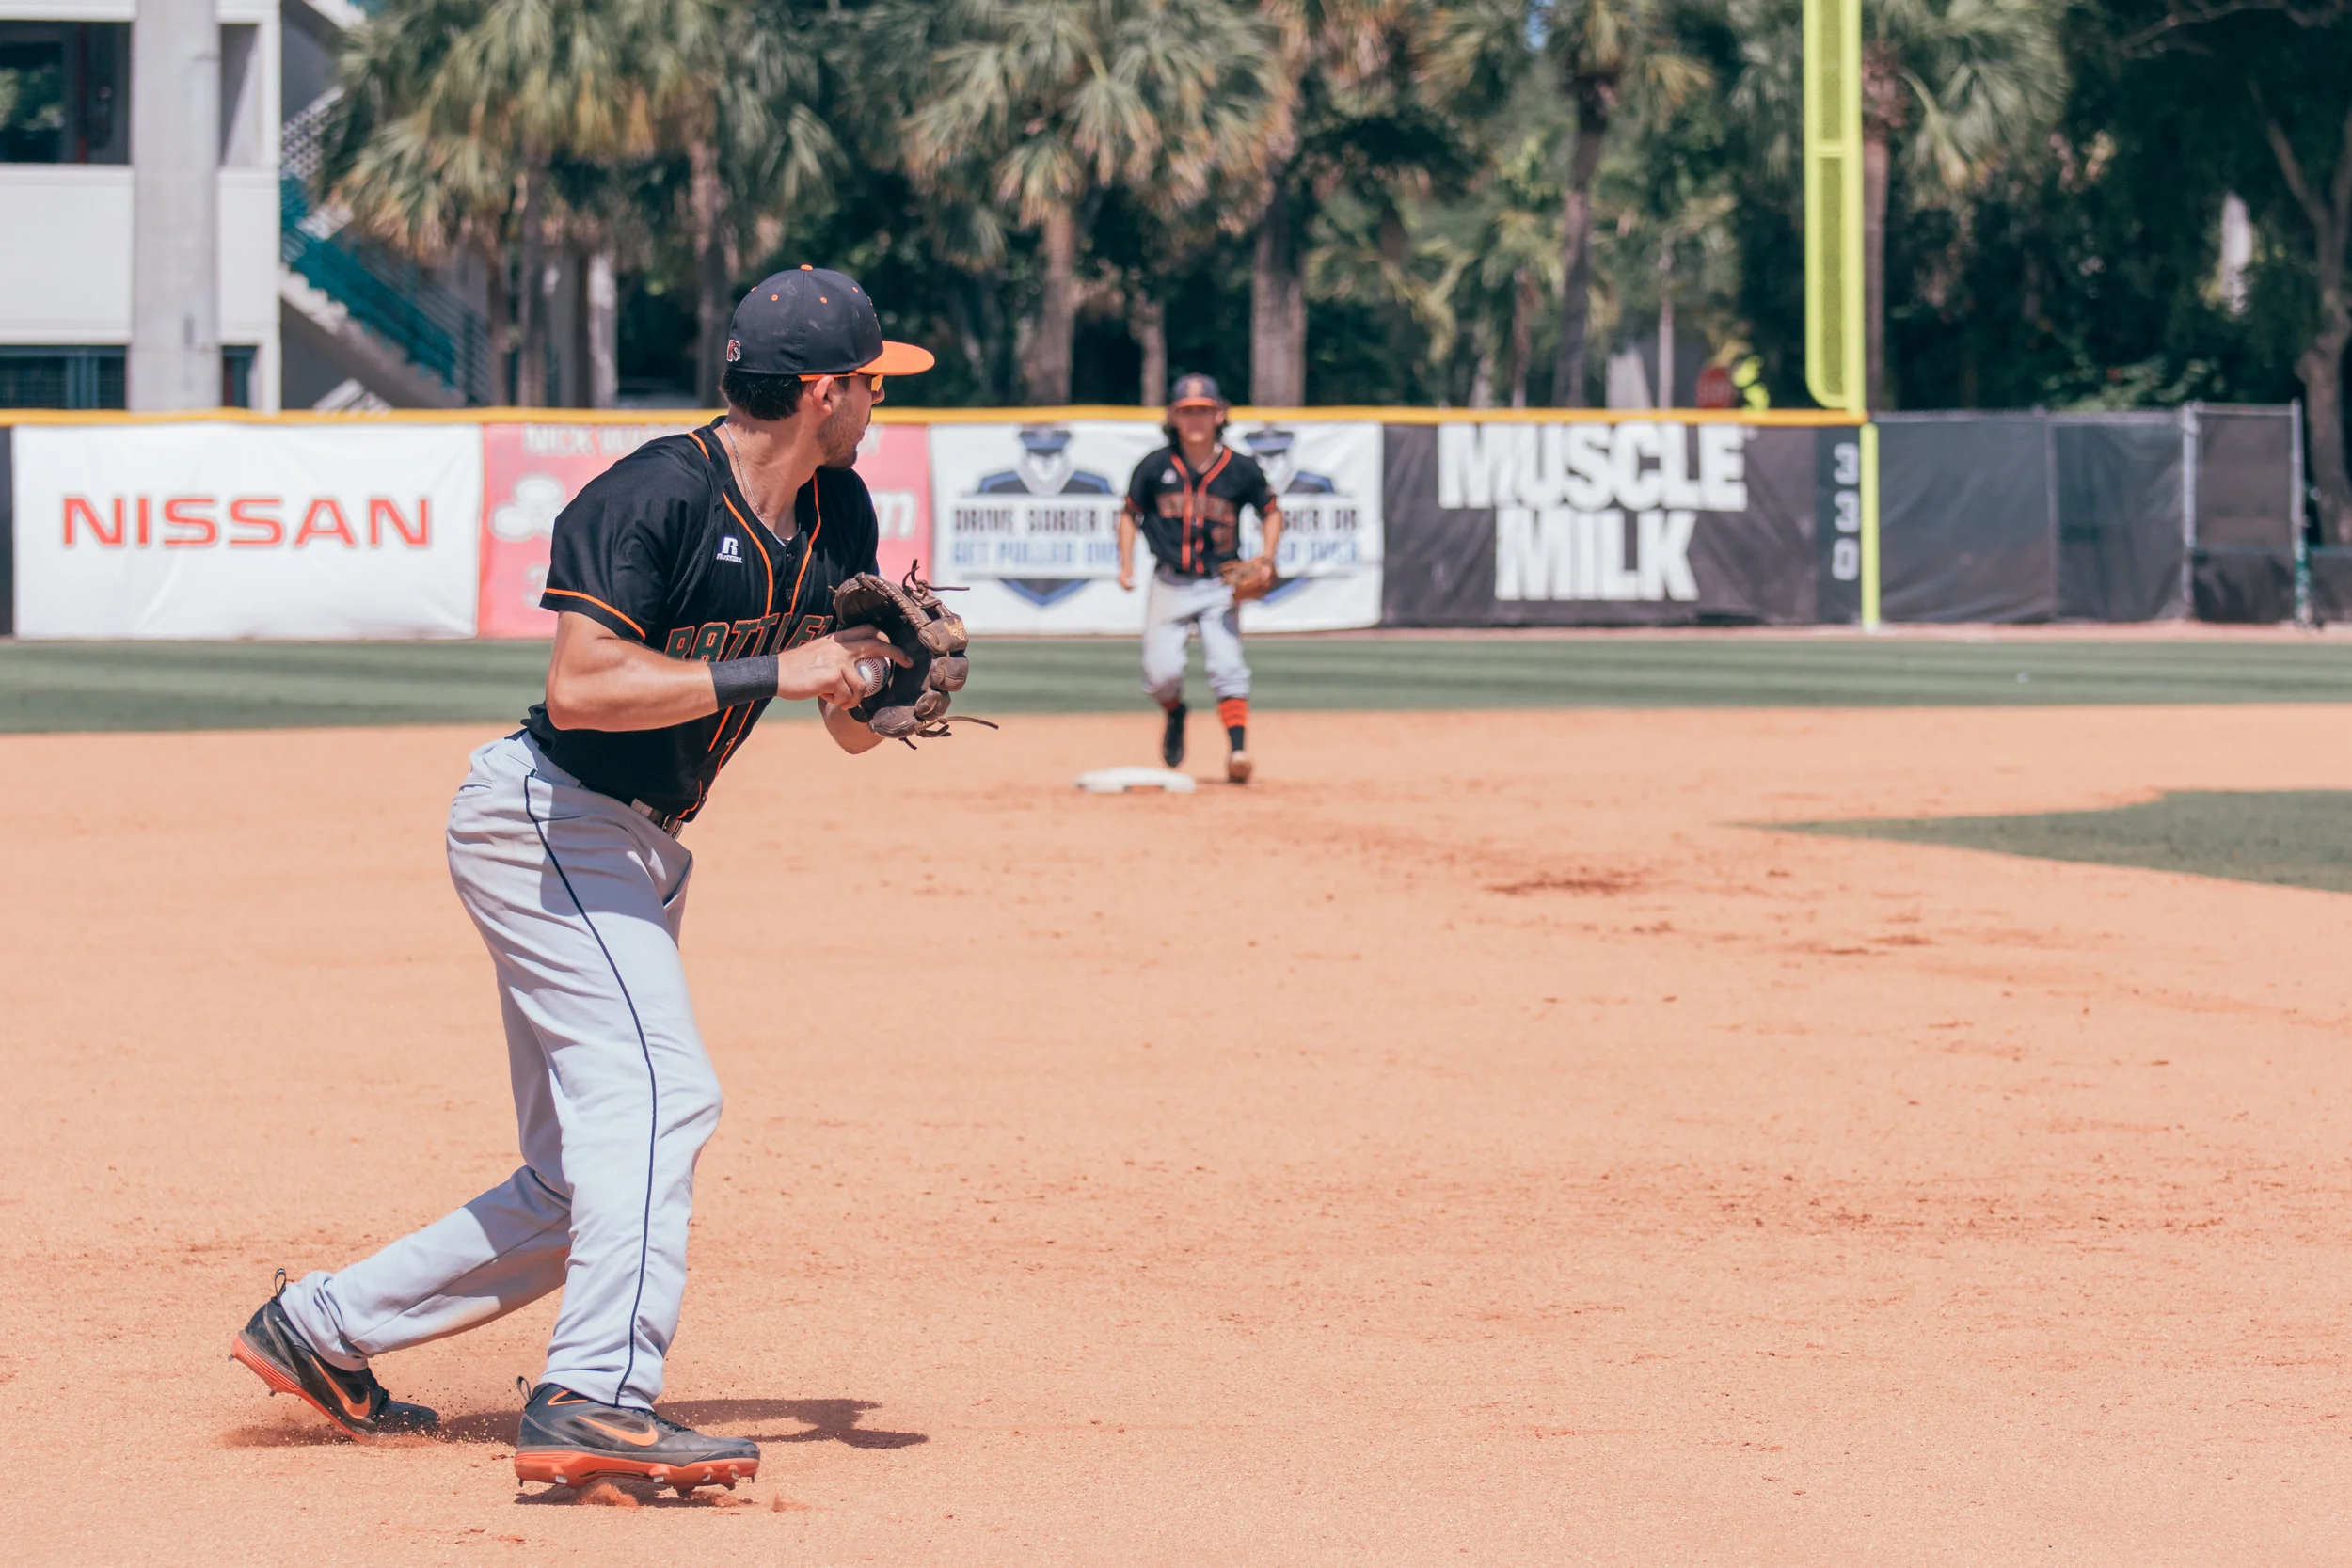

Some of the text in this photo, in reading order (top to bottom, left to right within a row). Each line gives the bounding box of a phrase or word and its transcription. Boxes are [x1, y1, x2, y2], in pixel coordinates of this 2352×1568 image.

[1438, 421, 1747, 511] MUSCLE
[62, 496, 429, 546] NISSAN
[722, 537, 739, 555] R
[1494, 509, 1700, 601] MILK
[1831, 442, 1860, 581] 330
